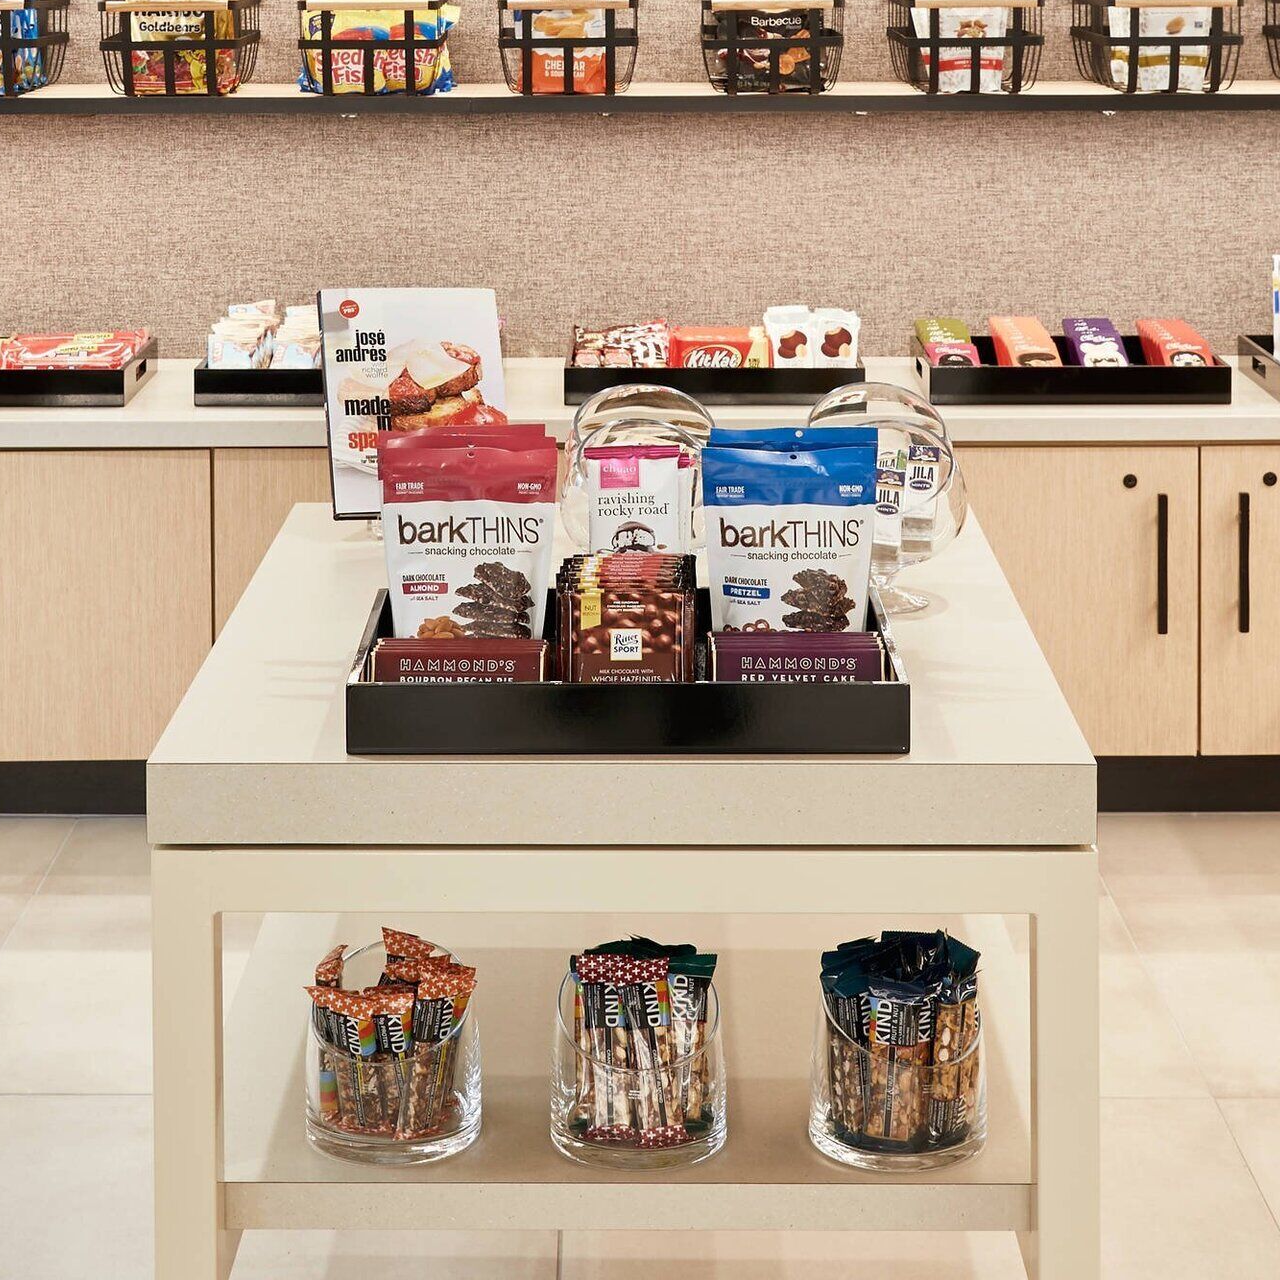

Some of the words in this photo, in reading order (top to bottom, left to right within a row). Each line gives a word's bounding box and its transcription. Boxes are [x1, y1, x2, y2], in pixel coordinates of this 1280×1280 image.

[139, 21, 201, 33] Goldbears
[751, 17, 802, 26] Barbecue
[545, 60, 585, 70] CHEAR
[333, 67, 365, 85] Fis
[355, 329, 386, 347] josé
[336, 345, 387, 363] andrés
[344, 396, 391, 416] made
[376, 415, 392, 431] in
[348, 432, 378, 452] spa
[910, 466, 933, 482] JILA
[716, 486, 727, 494] FAIR
[728, 486, 745, 494] TRADE
[839, 485, 863, 494] NON-GMO
[598, 493, 655, 505] ravishing
[598, 506, 634, 518] rocky
[638, 503, 667, 515] road
[398, 514, 541, 545] barkTHINS
[719, 517, 860, 547] barkTHINS
[424, 547, 467, 558] snacking
[469, 546, 516, 556] chocolate
[747, 550, 789, 561] snacking
[791, 550, 837, 560] chocolate
[402, 574, 415, 582] DARK
[416, 573, 445, 582] CHOCOLATE
[724, 576, 737, 585] DARK
[738, 577, 768, 586] CHOCOLATE
[410, 584, 439, 592] ALMOND
[730, 588, 761, 597] PRETZEL
[614, 633, 639, 645] Ritter
[613, 645, 639, 653] SPORT
[400, 659, 515, 672] HAMMOND'S
[742, 657, 856, 670] HAMMOND'S
[741, 674, 765, 682] RED
[772, 674, 817, 682] VELVET
[823, 674, 855, 682] CAKE
[604, 983, 619, 1027] KIND
[643, 982, 662, 1027] KIND
[439, 998, 455, 1041] KIND
[876, 999, 893, 1045] KIND
[346, 1015, 363, 1055] KIND
[387, 1015, 405, 1053] KIND
